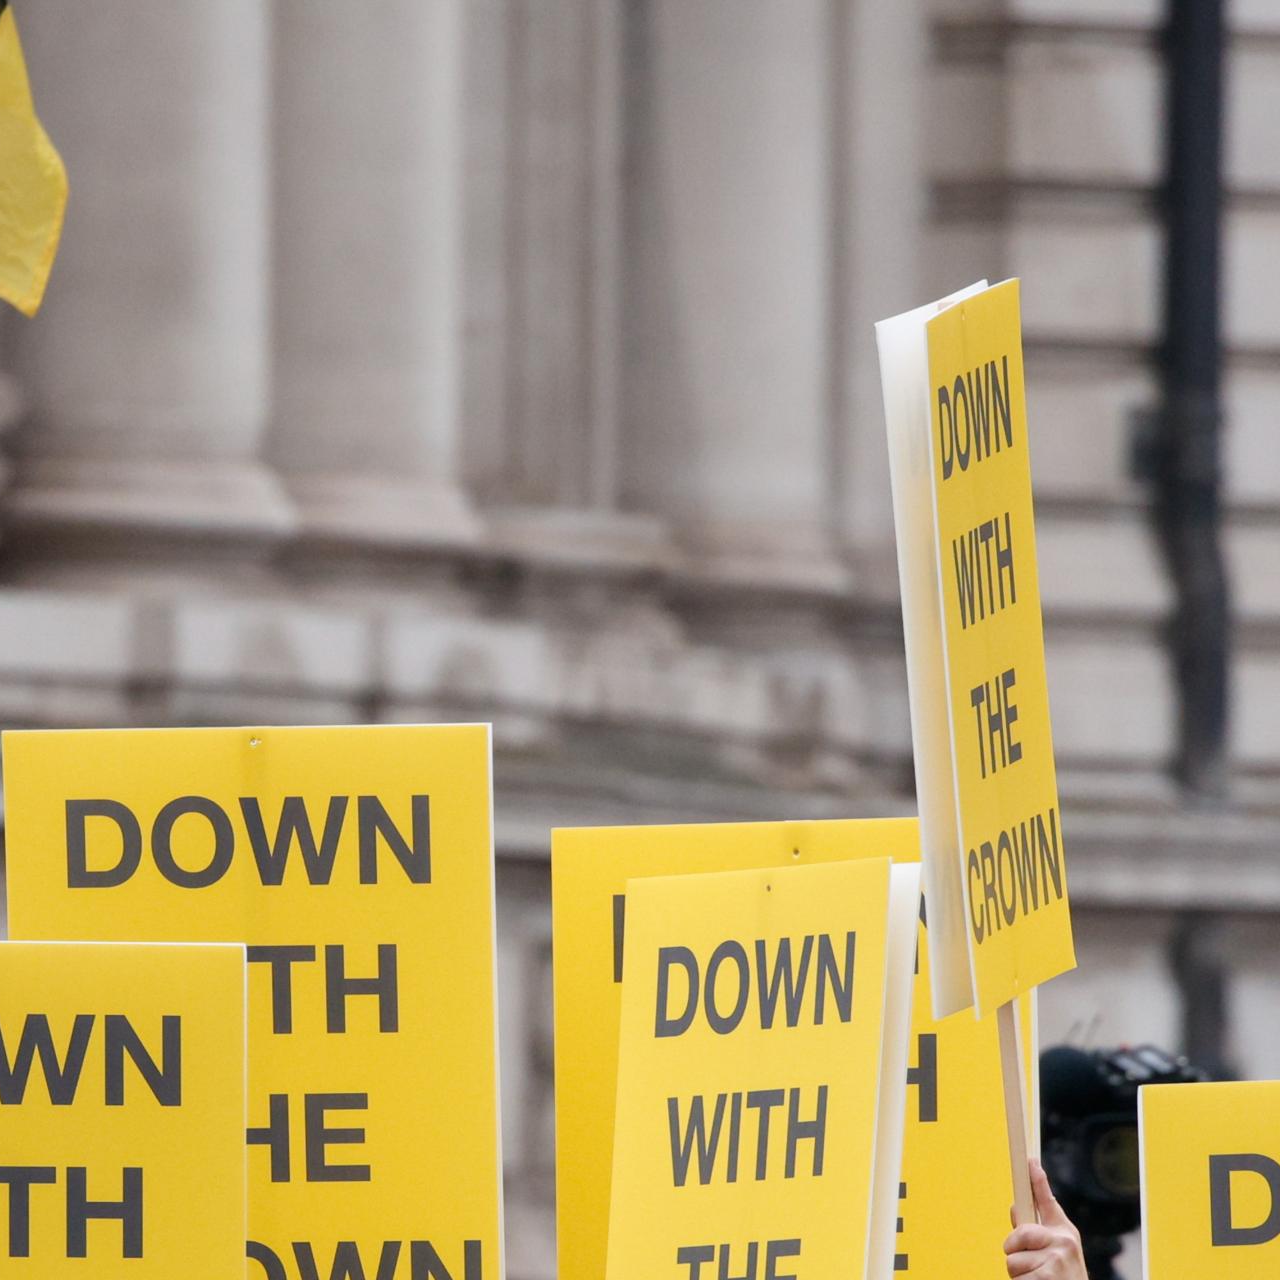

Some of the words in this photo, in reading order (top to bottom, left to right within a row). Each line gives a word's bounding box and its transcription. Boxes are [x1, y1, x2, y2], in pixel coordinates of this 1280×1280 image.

[937, 355, 1013, 480] DOWN
[952, 511, 1016, 630] WITH
[970, 667, 1022, 779] THE
[66, 796, 430, 888] DOWN
[967, 808, 1062, 945] CROWN
[247, 945, 397, 1033] TH
[656, 932, 855, 1036] DOWN
[247, 1093, 370, 1182] HE
[669, 1086, 827, 1186] WITH
